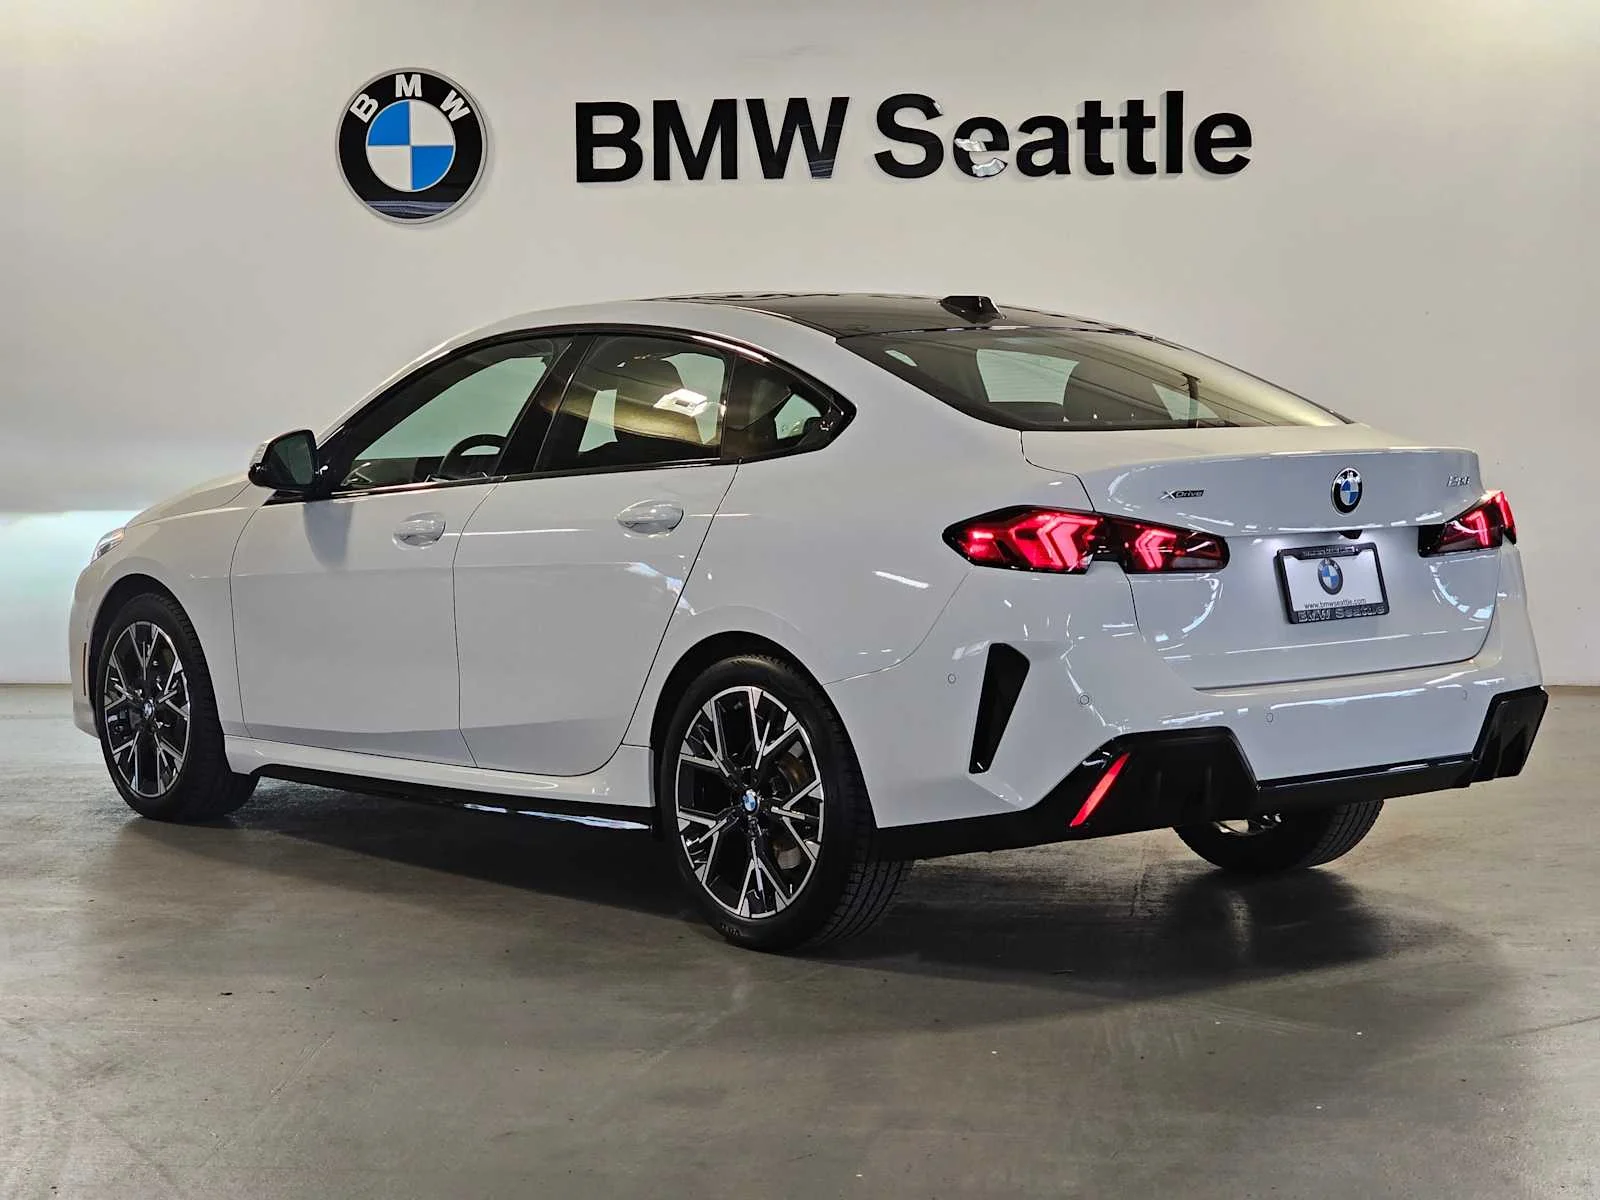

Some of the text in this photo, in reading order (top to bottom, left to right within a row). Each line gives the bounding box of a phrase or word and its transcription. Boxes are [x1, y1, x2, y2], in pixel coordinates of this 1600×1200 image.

[349, 73, 471, 123] BMW
[575, 90, 1253, 184] BMW Seattle
